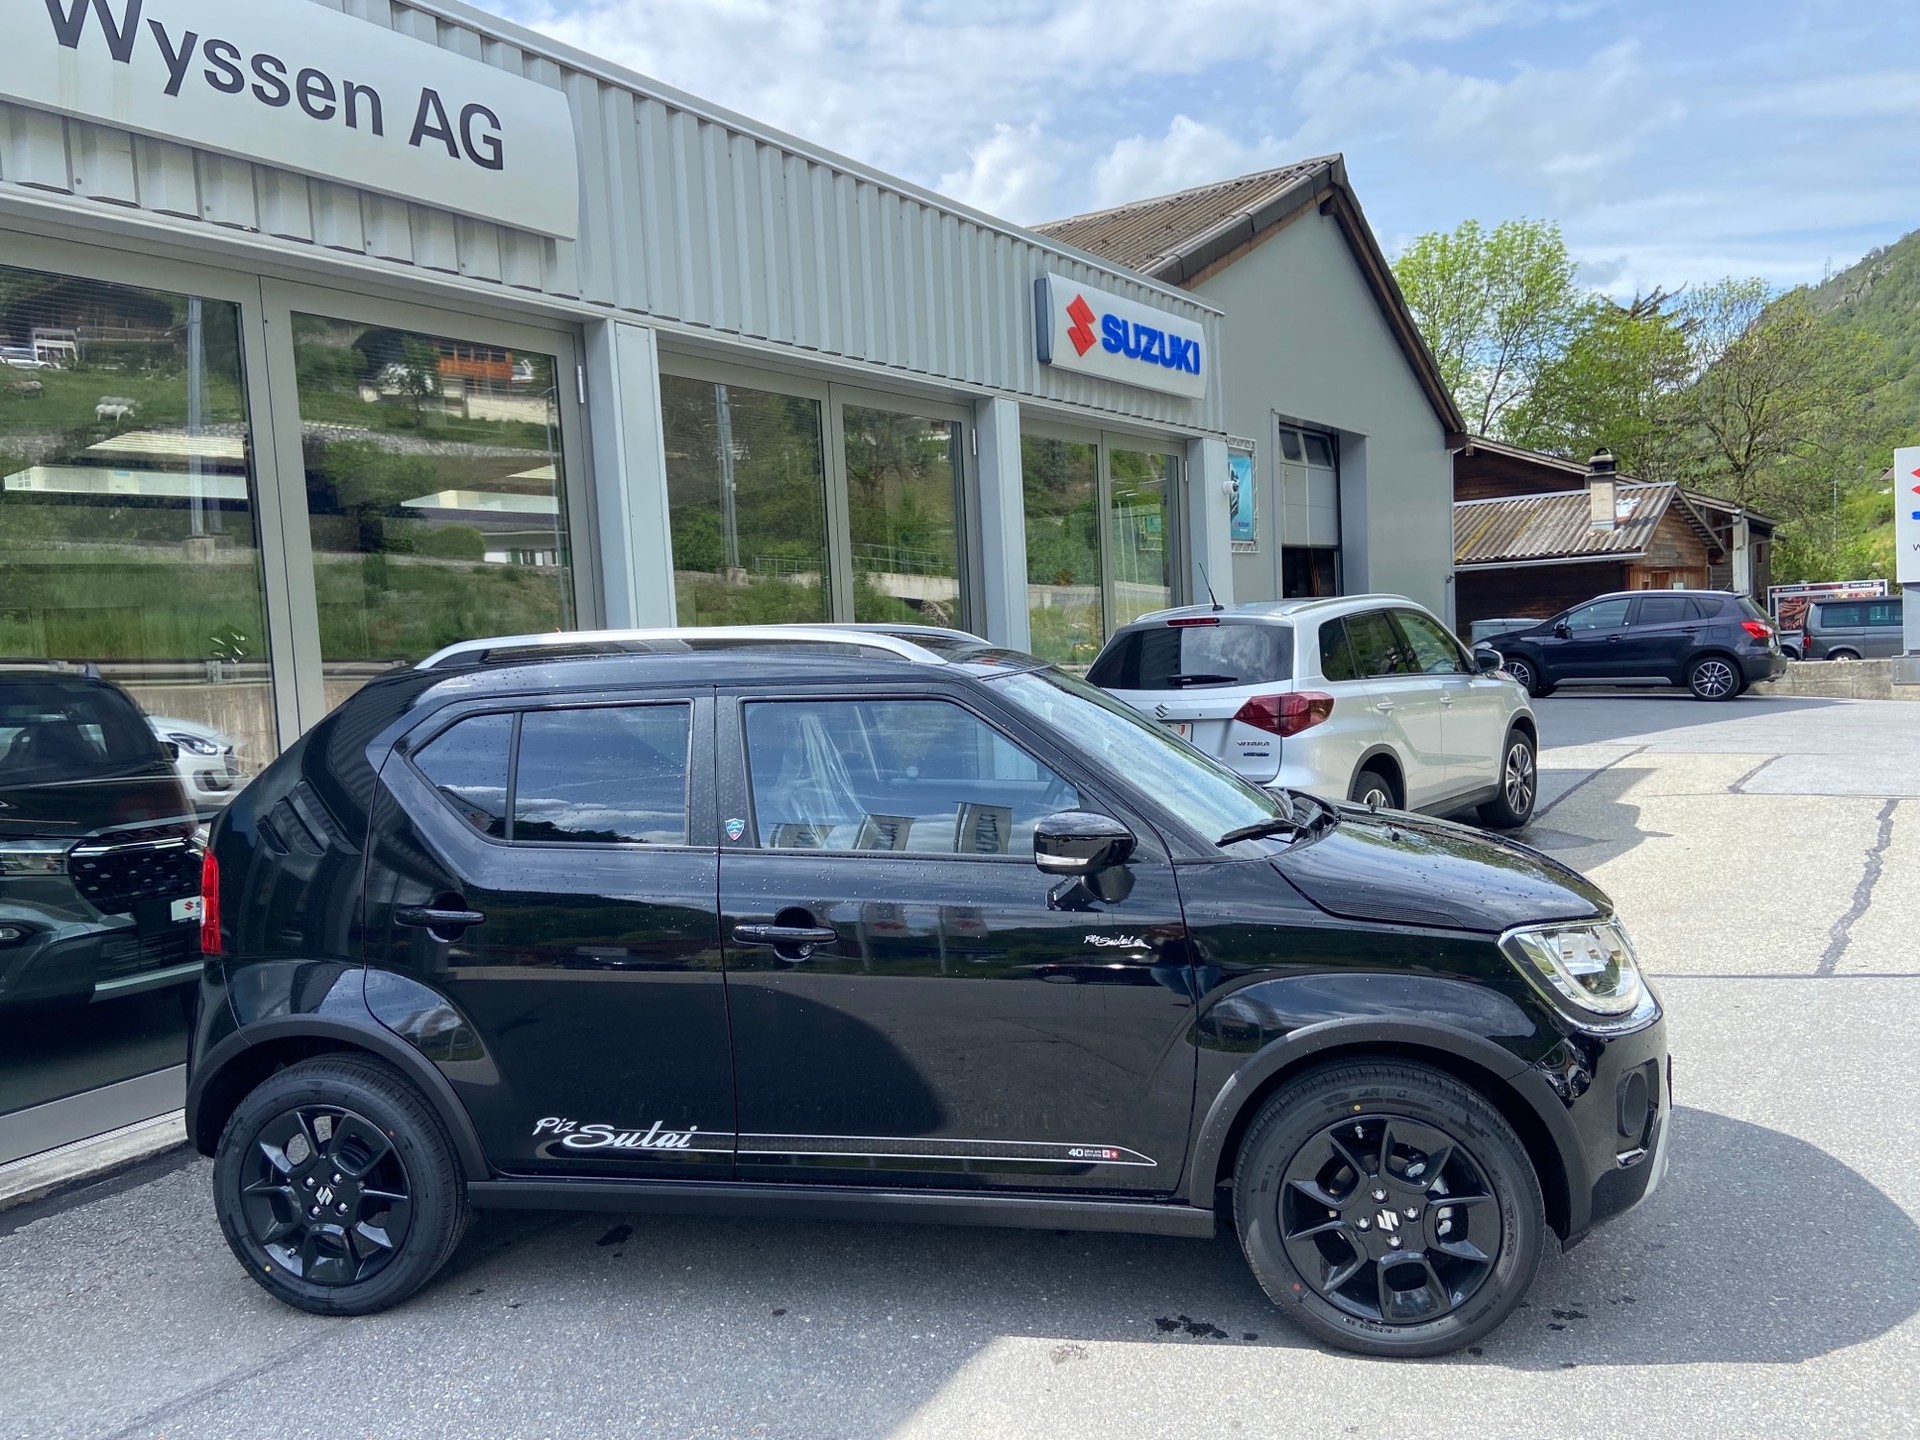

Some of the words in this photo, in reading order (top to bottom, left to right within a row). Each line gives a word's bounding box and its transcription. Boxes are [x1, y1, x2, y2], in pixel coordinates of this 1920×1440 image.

[46, 0, 385, 137] Wyssen
[408, 87, 505, 172] AG
[1101, 313, 1201, 376] SUZUKI
[531, 1116, 578, 1136] Piz
[562, 1120, 698, 1148] Sulai
[1067, 1147, 1084, 1157] 40
